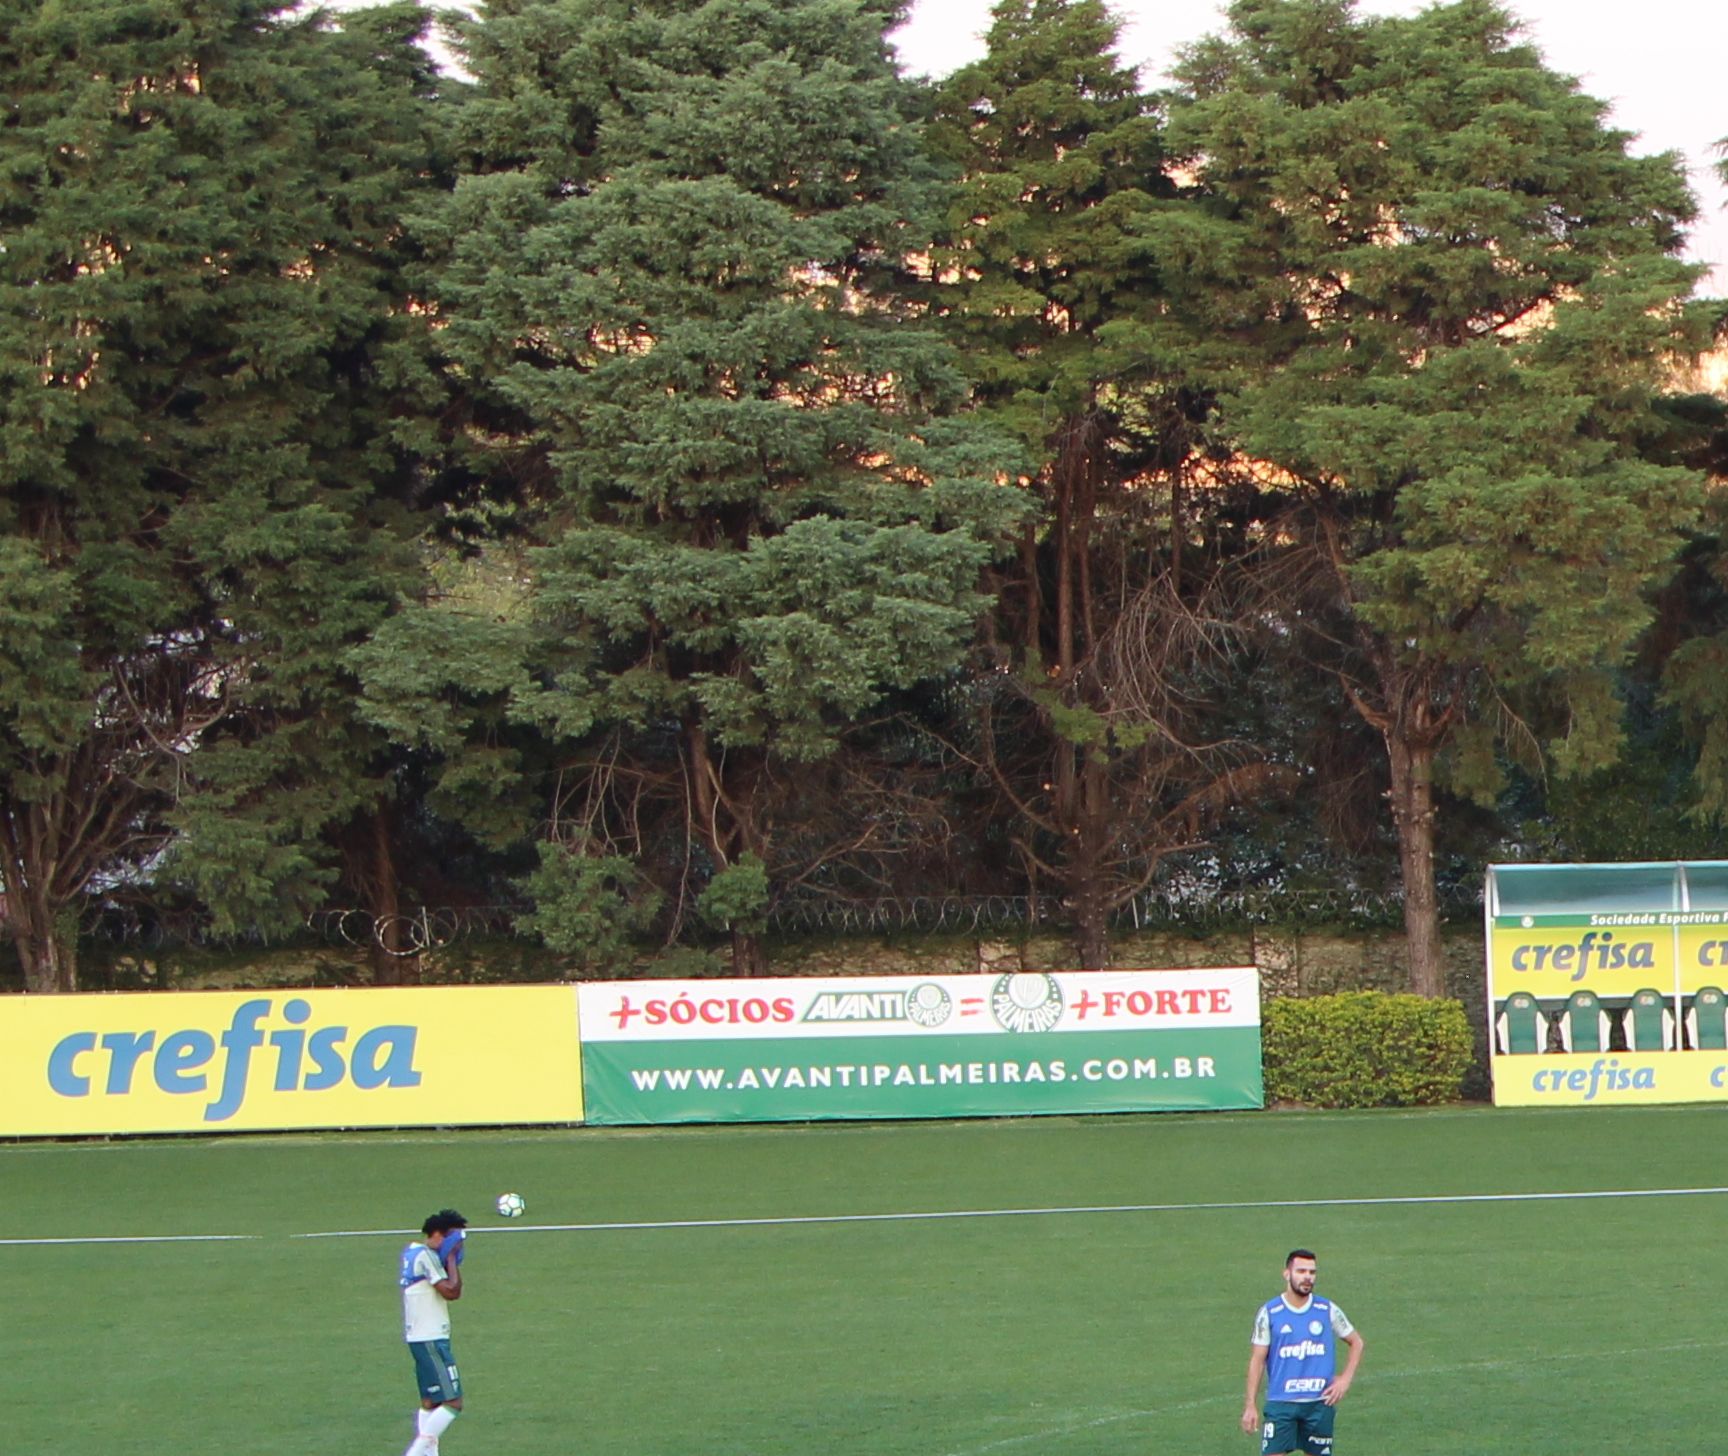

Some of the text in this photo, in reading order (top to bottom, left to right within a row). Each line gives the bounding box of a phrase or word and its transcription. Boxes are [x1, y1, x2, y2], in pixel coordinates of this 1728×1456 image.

[1590, 913, 1657, 926] Sociedade
[1659, 911, 1720, 925] Esportiva
[1512, 931, 1655, 982] crefisa
[806, 992, 904, 1021] AVANTI
[992, 991, 1062, 1034] PALMEIRAS
[48, 998, 423, 1122] crefisa
[632, 1057, 1216, 1092] WWW.AVANTIPALMEIRAS.COM.BR
[1532, 1059, 1656, 1101] crefisa
[1279, 1340, 1325, 1360] crefisa
